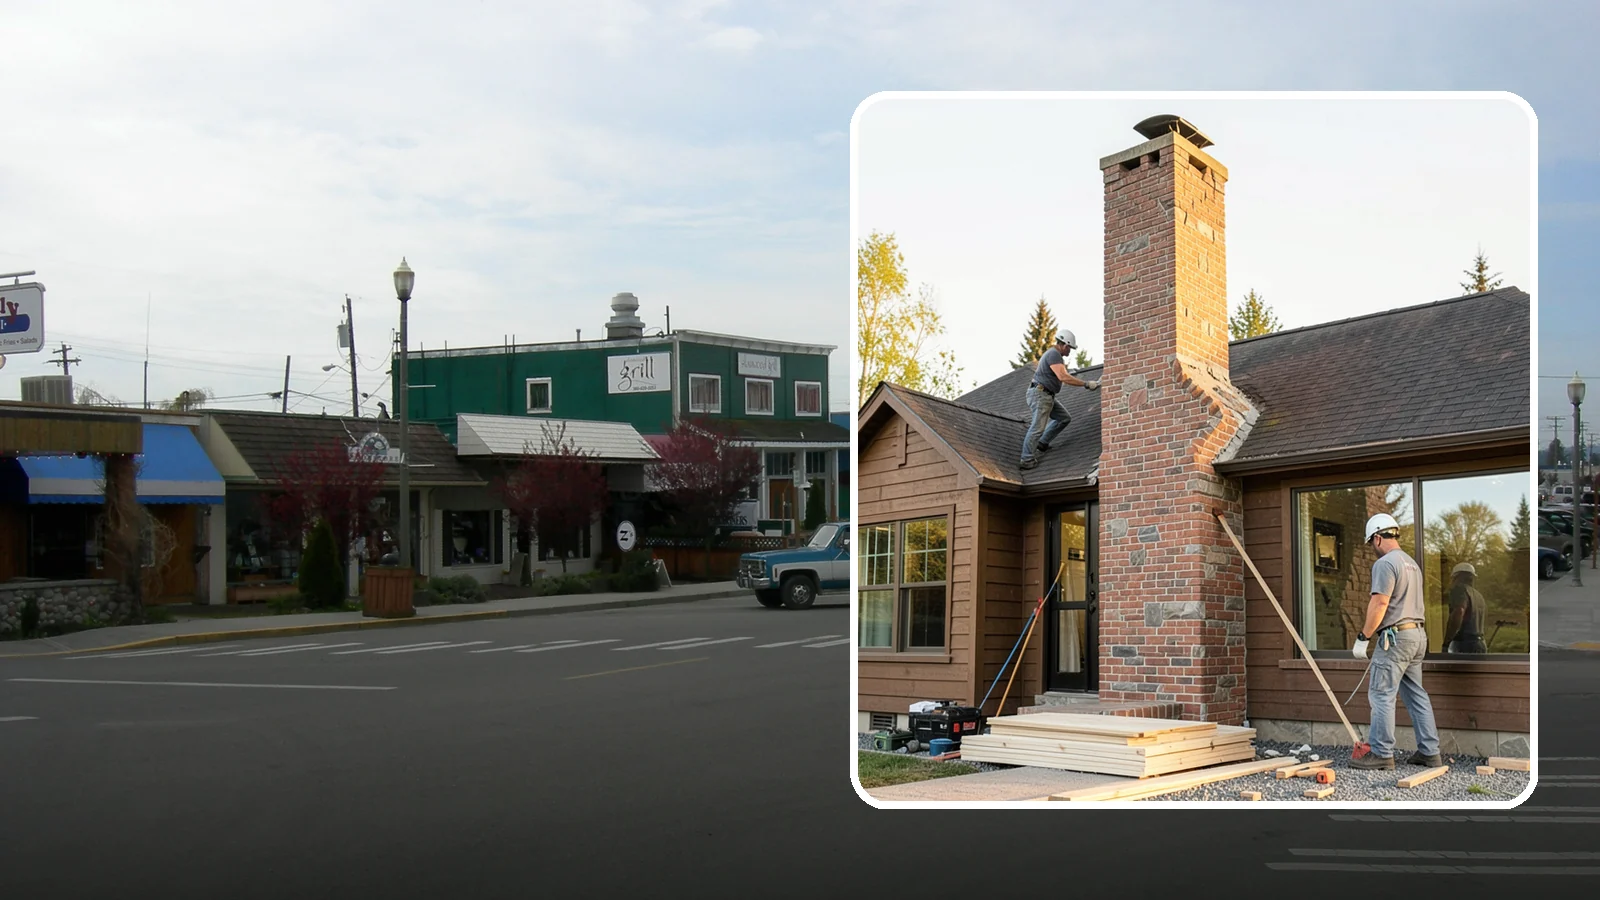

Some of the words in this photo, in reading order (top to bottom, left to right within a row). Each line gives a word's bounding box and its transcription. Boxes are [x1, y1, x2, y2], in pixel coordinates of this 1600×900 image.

[3, 338, 16, 346] Fries
[20, 336, 38, 345] Salads
[618, 355, 655, 391] grill
